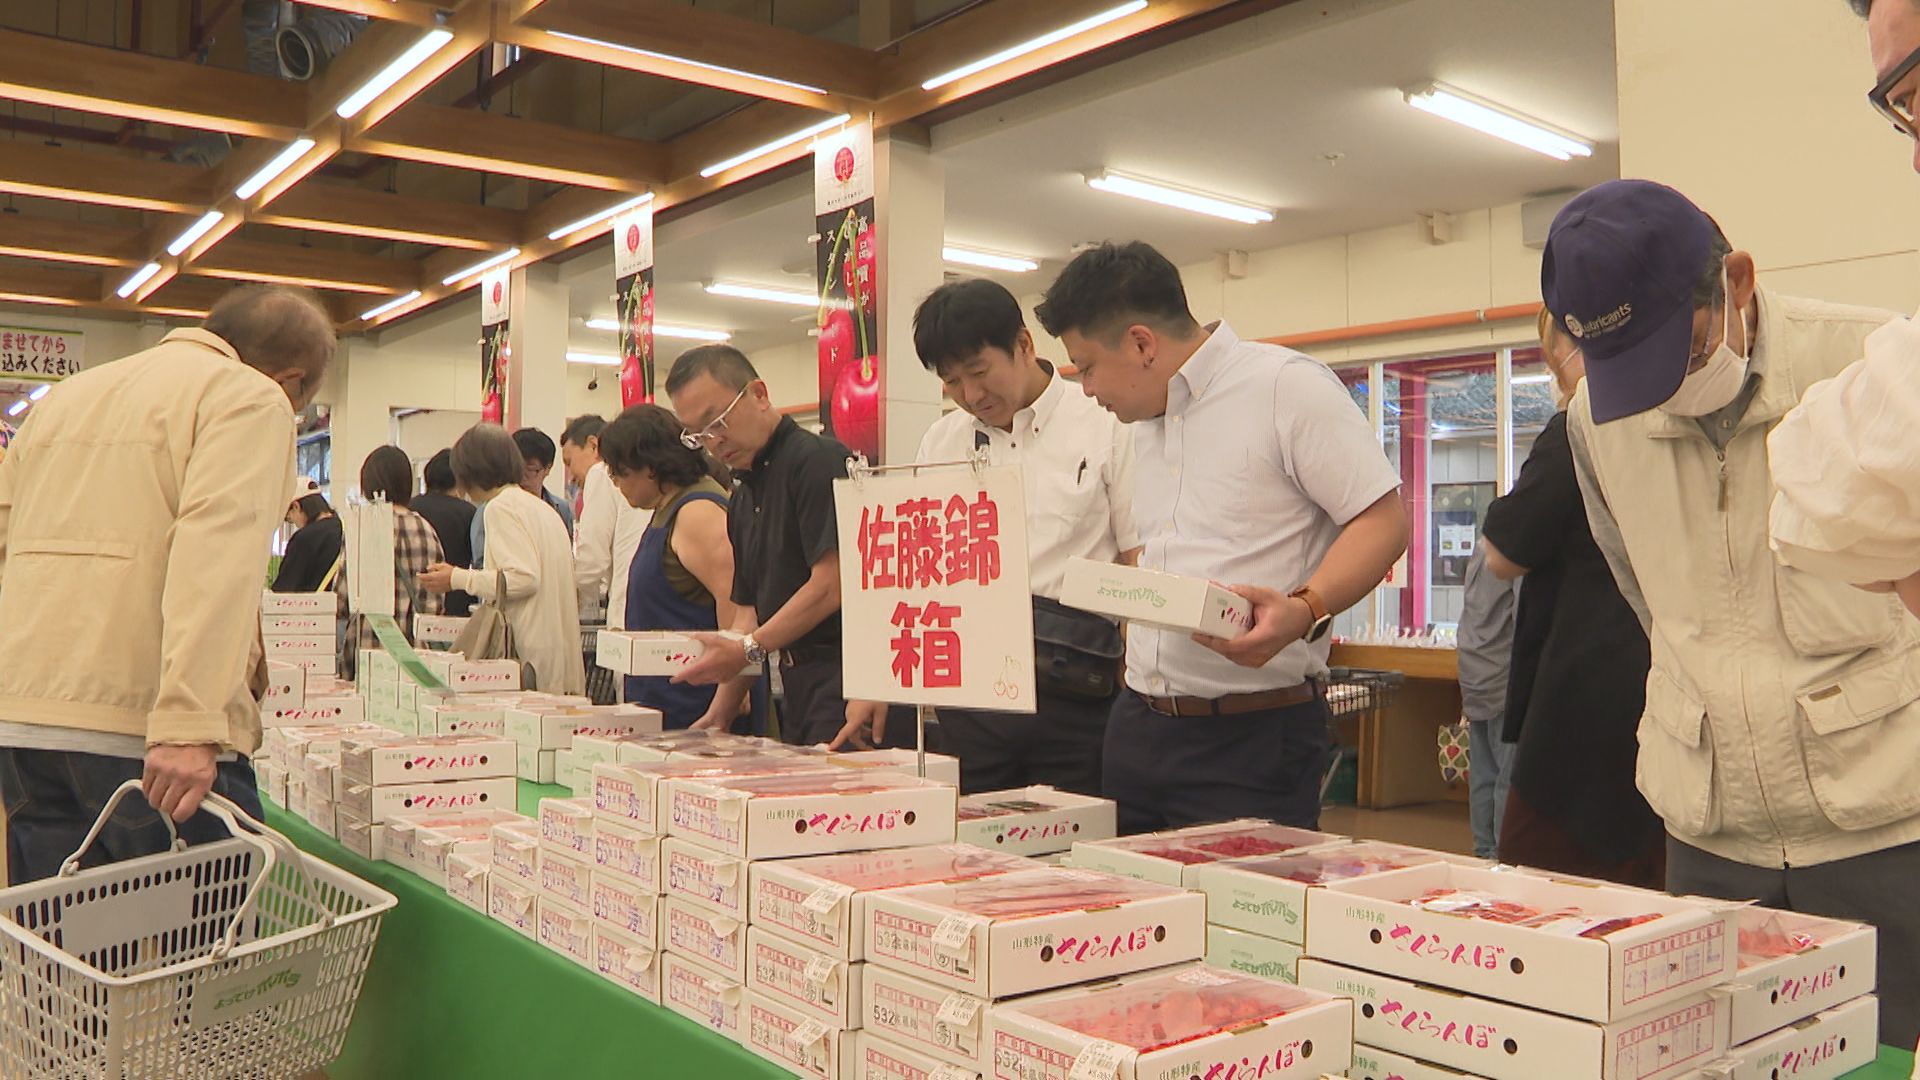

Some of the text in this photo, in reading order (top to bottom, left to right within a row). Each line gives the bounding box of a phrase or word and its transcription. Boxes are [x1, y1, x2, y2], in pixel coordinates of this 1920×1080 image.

[2, 353, 80, 376] 込みください
[857, 490, 1001, 590] 佐藤錦
[890, 600, 962, 688] 箱
[808, 809, 903, 837] さくらんぼ
[1056, 925, 1153, 964] さくらんぼ
[1389, 922, 1505, 971] さくらんぼ
[1781, 964, 1837, 1004] さくらんぼ
[873, 1005, 896, 1026] 532
[1379, 997, 1498, 1049] さくらんぼ
[1781, 1034, 1838, 1078] さくらんぼ
